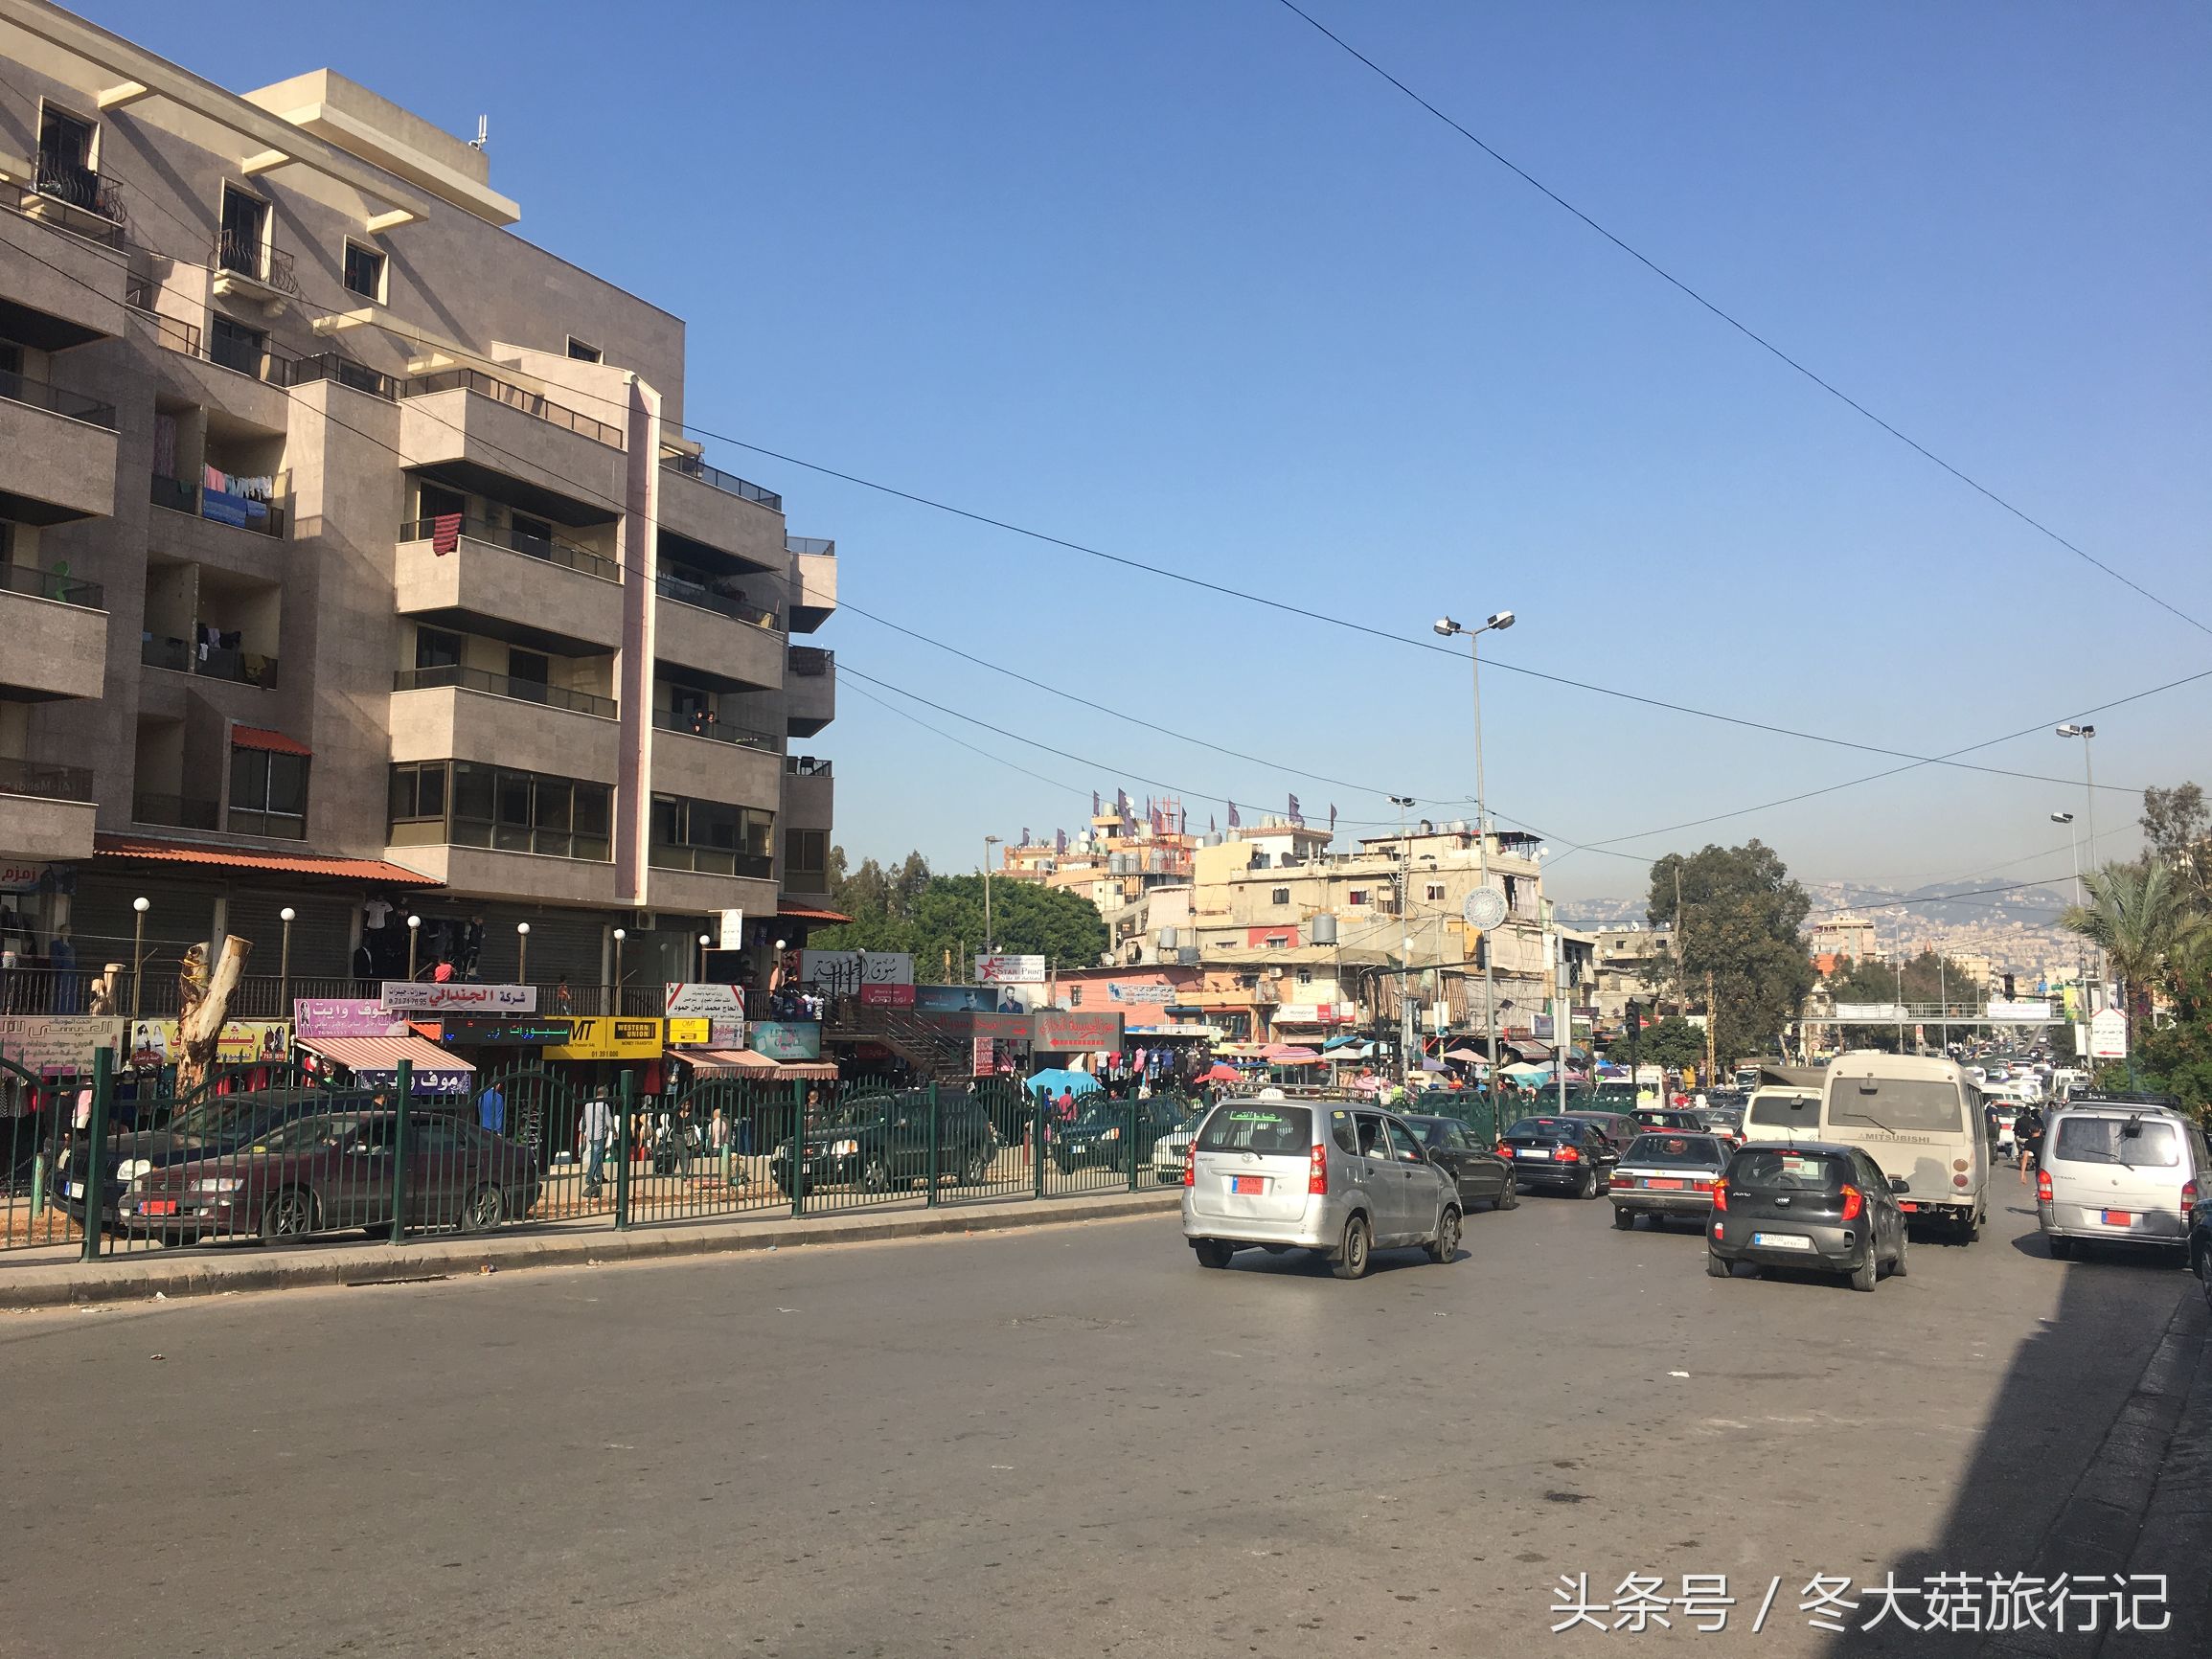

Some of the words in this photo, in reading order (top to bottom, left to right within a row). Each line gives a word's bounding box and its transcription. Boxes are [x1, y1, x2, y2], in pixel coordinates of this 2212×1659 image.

[499, 991, 526, 1005] شركة
[312, 1002, 349, 1019] وايت
[568, 1019, 596, 1040] MT
[421, 1070, 458, 1091] موف
[1865, 1133, 1930, 1144] MITSUBISHI
